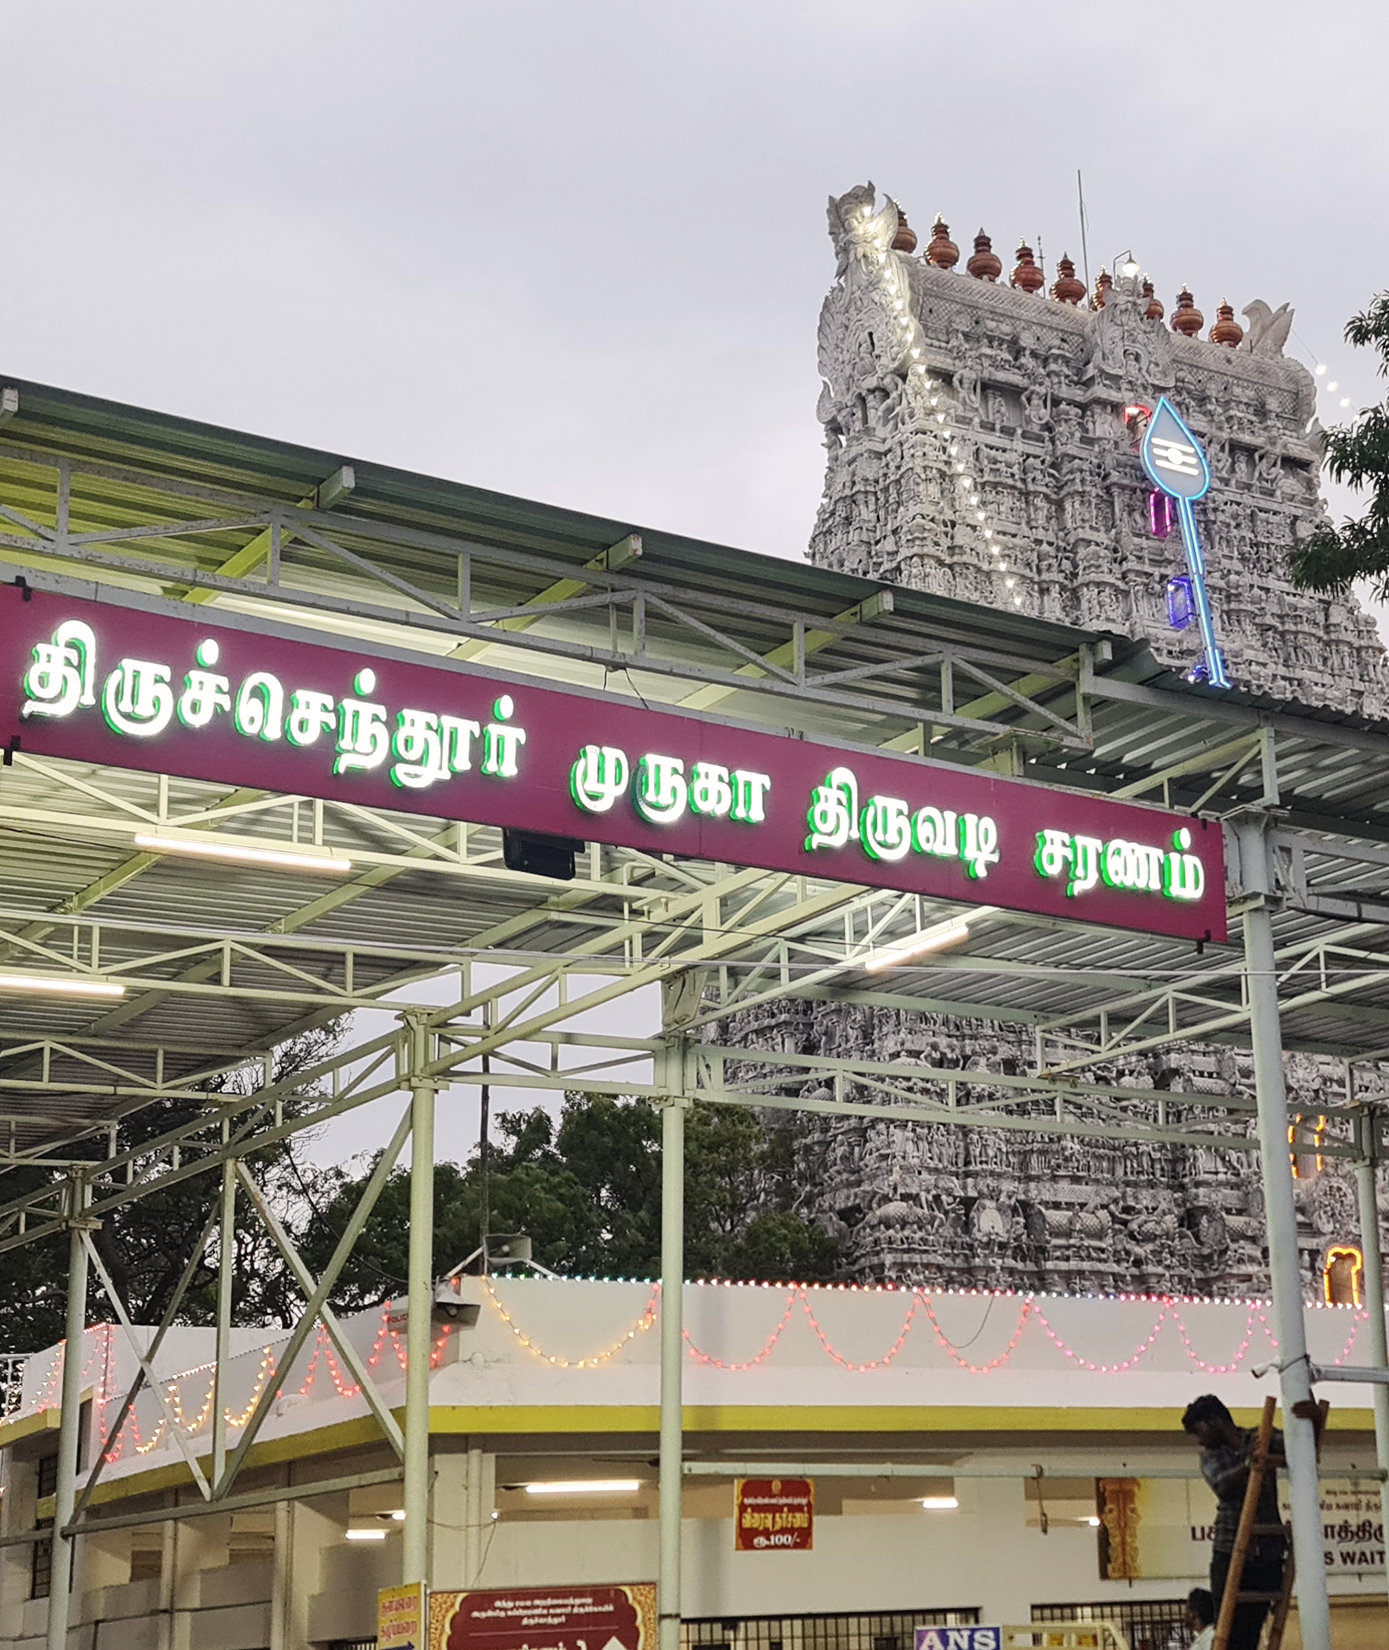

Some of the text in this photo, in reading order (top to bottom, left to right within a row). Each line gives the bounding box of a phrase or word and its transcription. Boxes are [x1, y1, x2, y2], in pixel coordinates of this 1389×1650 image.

[22, 619, 1205, 899] திருச்செந்தூர் முருகா திருவடி சரணம்
[920, 1630, 997, 1650] ANS
